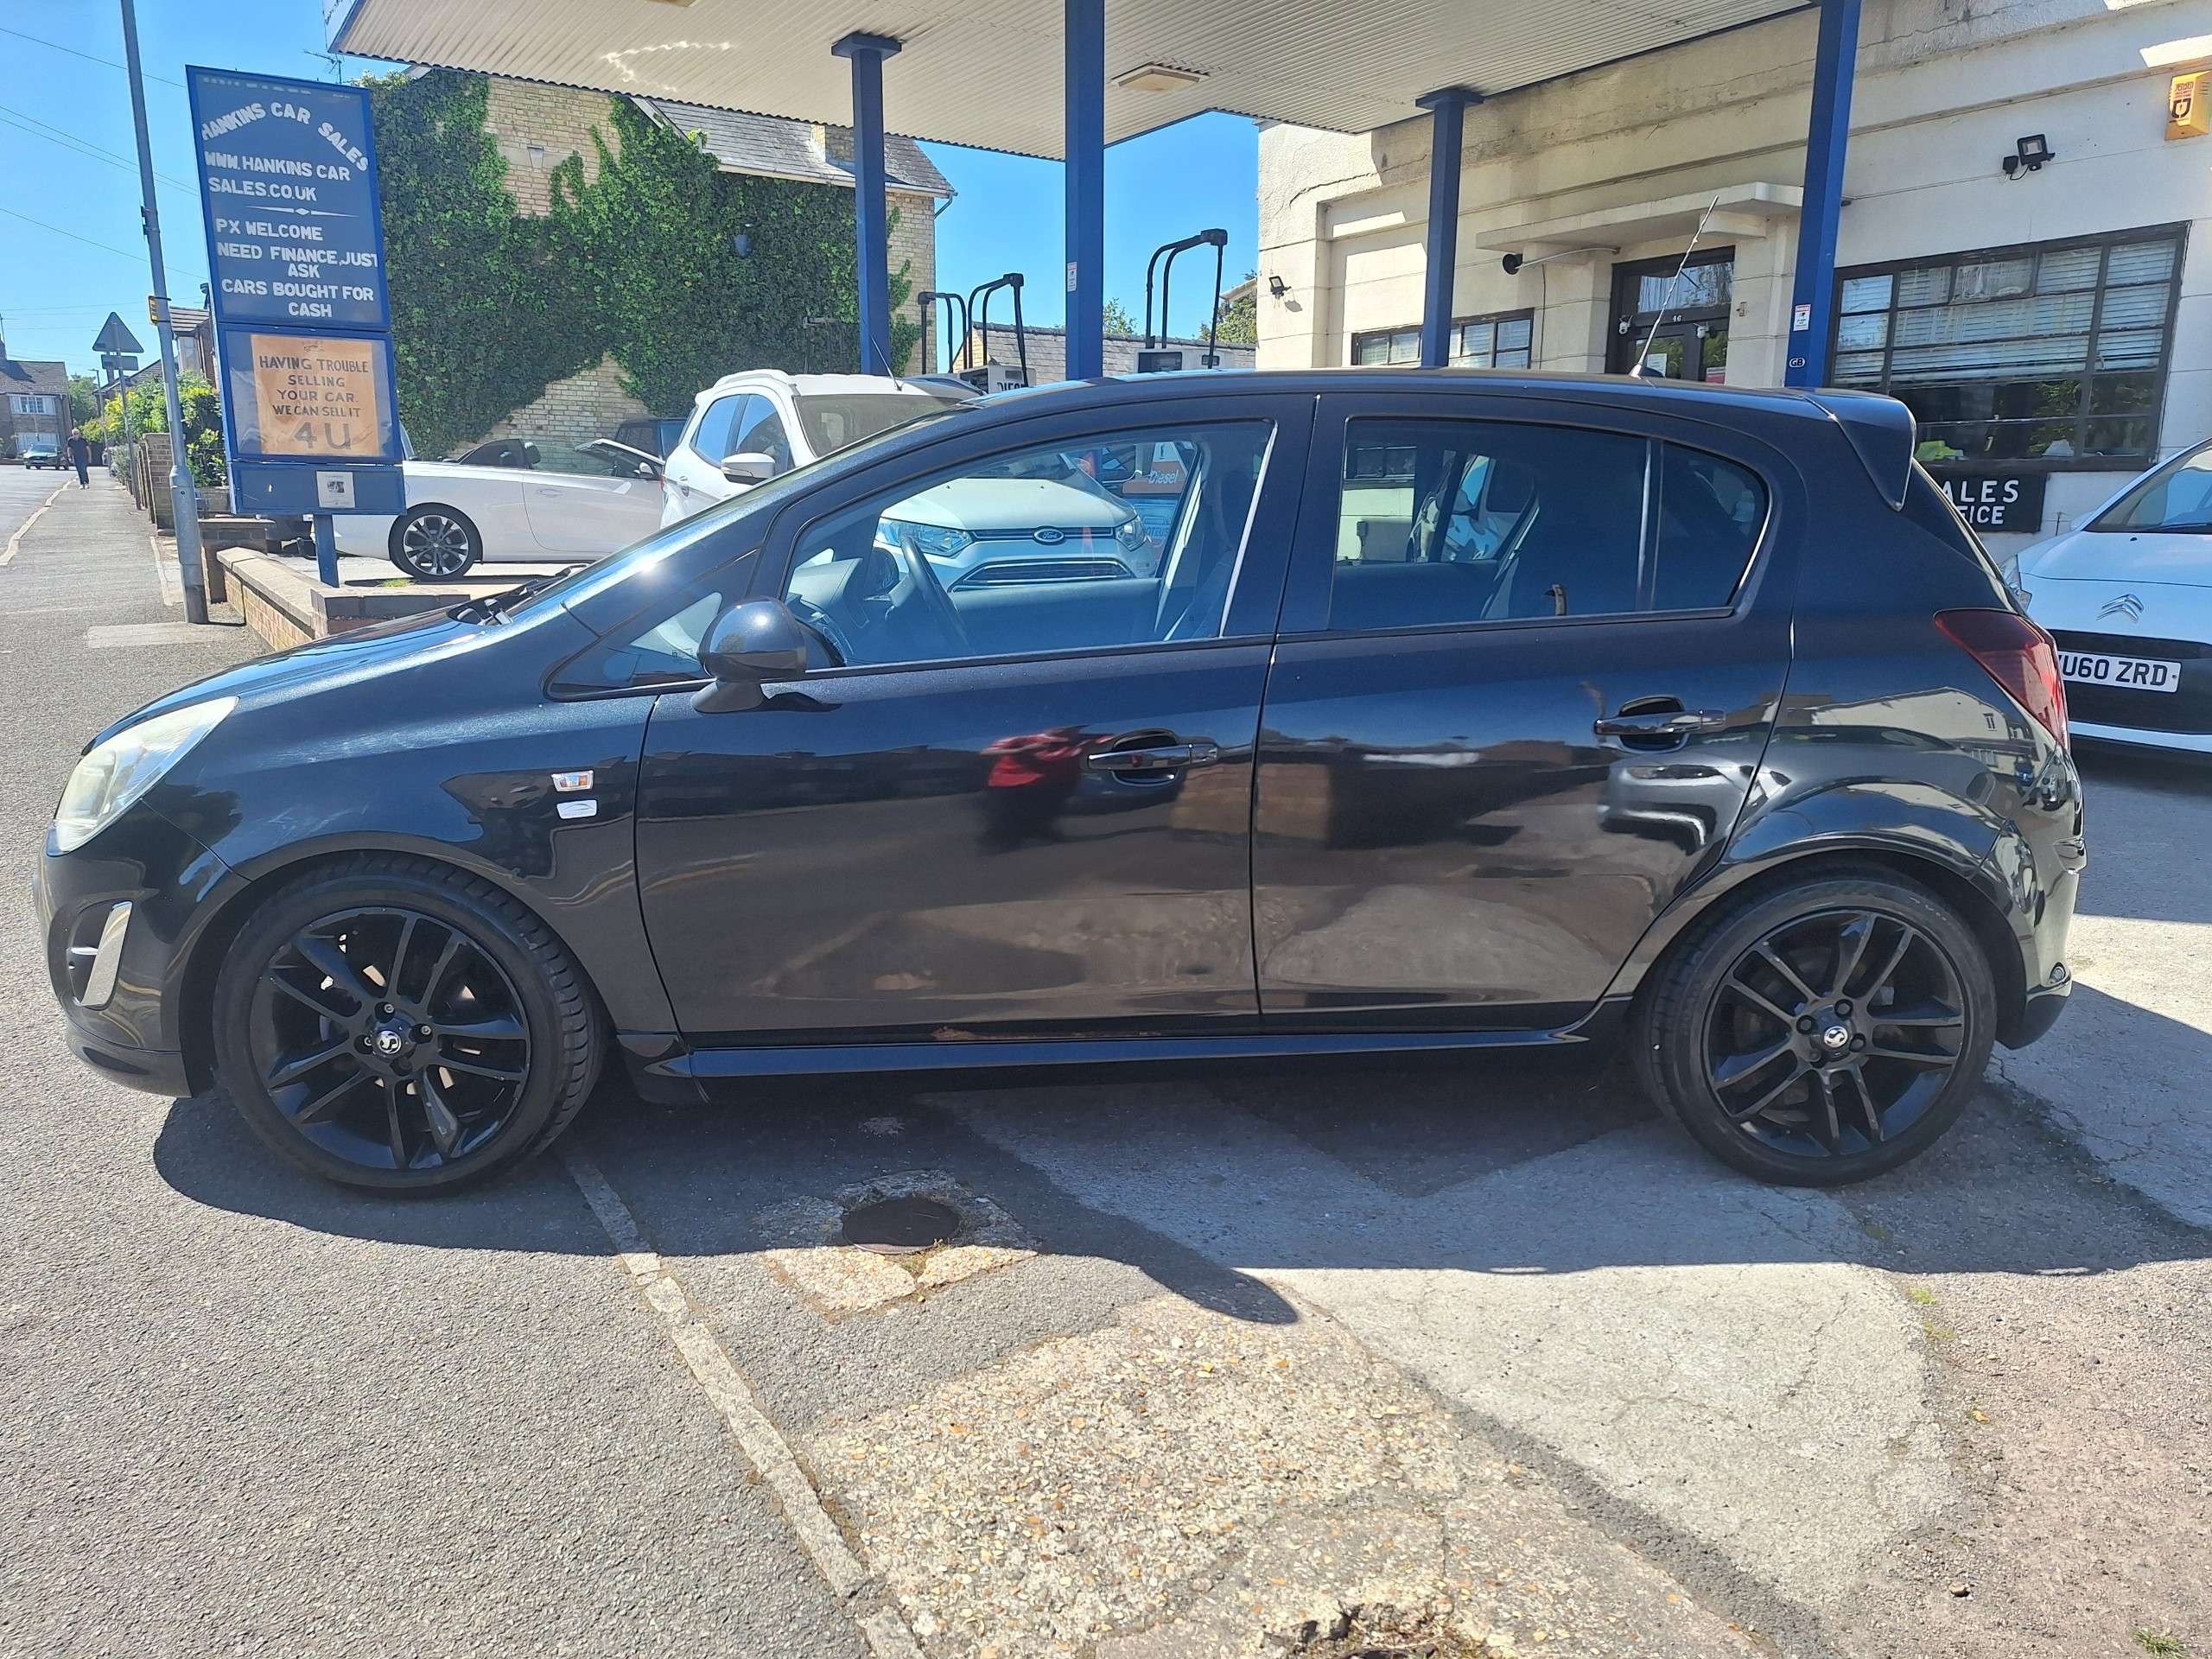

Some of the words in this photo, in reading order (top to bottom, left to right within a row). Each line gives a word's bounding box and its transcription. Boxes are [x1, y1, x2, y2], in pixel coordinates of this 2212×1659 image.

[201, 102, 266, 141] HANKINS
[270, 102, 311, 124] CAR
[318, 122, 369, 171] SALES
[316, 164, 351, 181] CAR
[208, 177, 317, 201] SALES.CO.UK
[216, 219, 241, 234] PX
[245, 221, 323, 241] WELCOME
[217, 242, 263, 259] NEED
[288, 263, 320, 278] ASK
[221, 278, 268, 296] CARS
[273, 282, 338, 299] BOUGHT
[342, 285, 374, 302] FOR
[288, 302, 333, 318] CASH
[259, 355, 313, 370] HAVING
[316, 359, 369, 373] TROUBLE
[288, 374, 345, 387] SELLING
[276, 390, 318, 402] YOUR
[272, 404, 292, 416] WE
[294, 405, 319, 416] CAN
[322, 407, 346, 417] SELL
[349, 407, 361, 417] IT
[294, 422, 317, 448] 4
[2058, 654, 2110, 680] U60
[2115, 661, 2169, 686] ZRD
